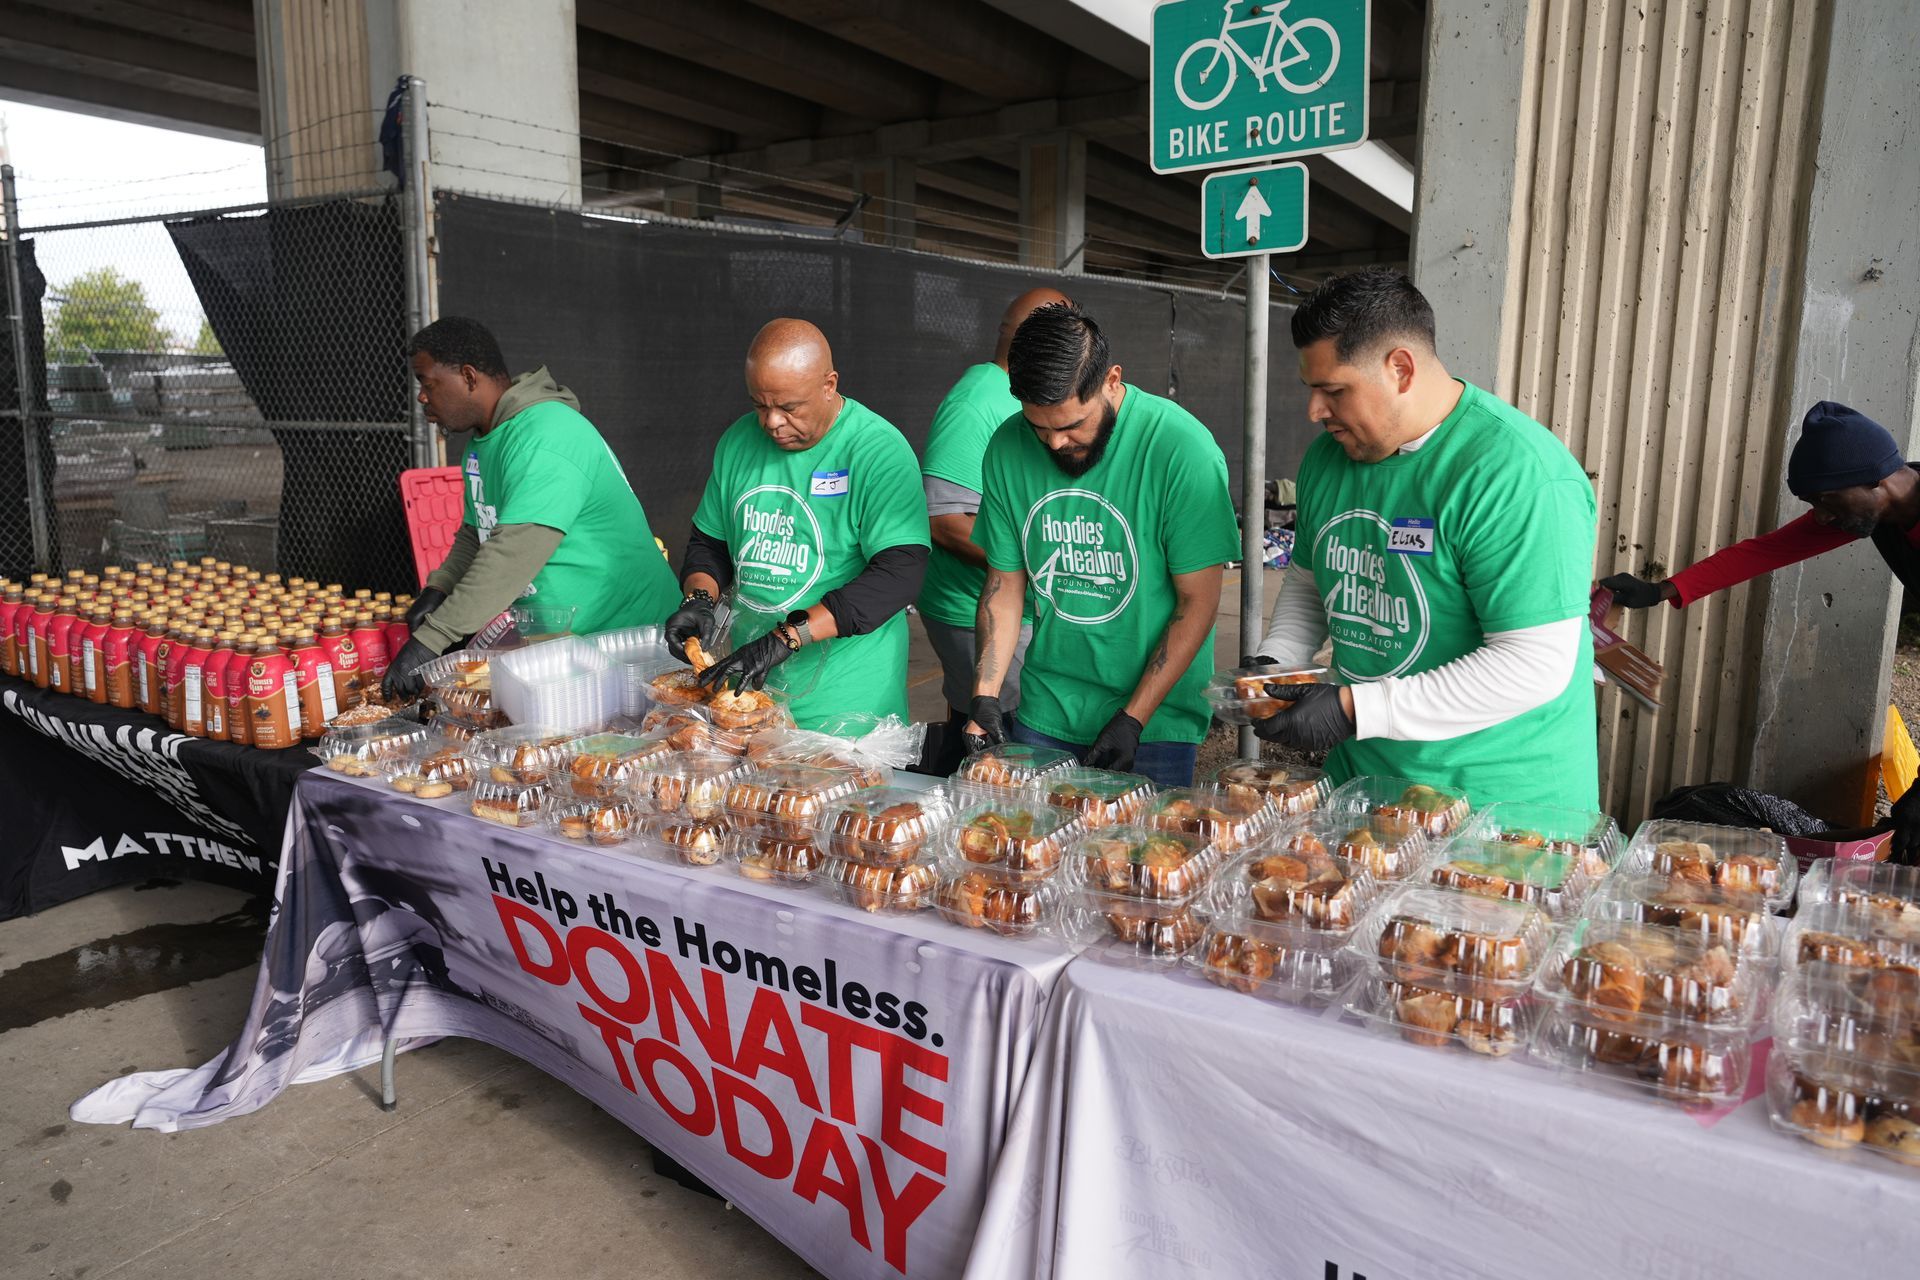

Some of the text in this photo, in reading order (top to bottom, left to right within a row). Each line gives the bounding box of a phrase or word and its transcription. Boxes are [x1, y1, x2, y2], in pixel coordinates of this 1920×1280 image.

[1169, 101, 1345, 160] BIKE ROUTE
[743, 503, 795, 537] Hoodies
[1041, 513, 1104, 545] Hoodies
[1392, 530, 1425, 549] ELIAS
[751, 532, 809, 573] Healing
[1061, 543, 1127, 582] Healing
[1325, 534, 1386, 584] Hoodies
[1057, 577, 1121, 595] FOUNDATION
[1342, 573, 1410, 633] Healing
[1331, 623, 1402, 649] FOUNDATION
[61, 832, 262, 875] MATTHEW
[481, 857, 945, 1048] Help the Homeless.
[491, 893, 949, 1177] DONATE
[576, 1001, 946, 1276] TODAY
